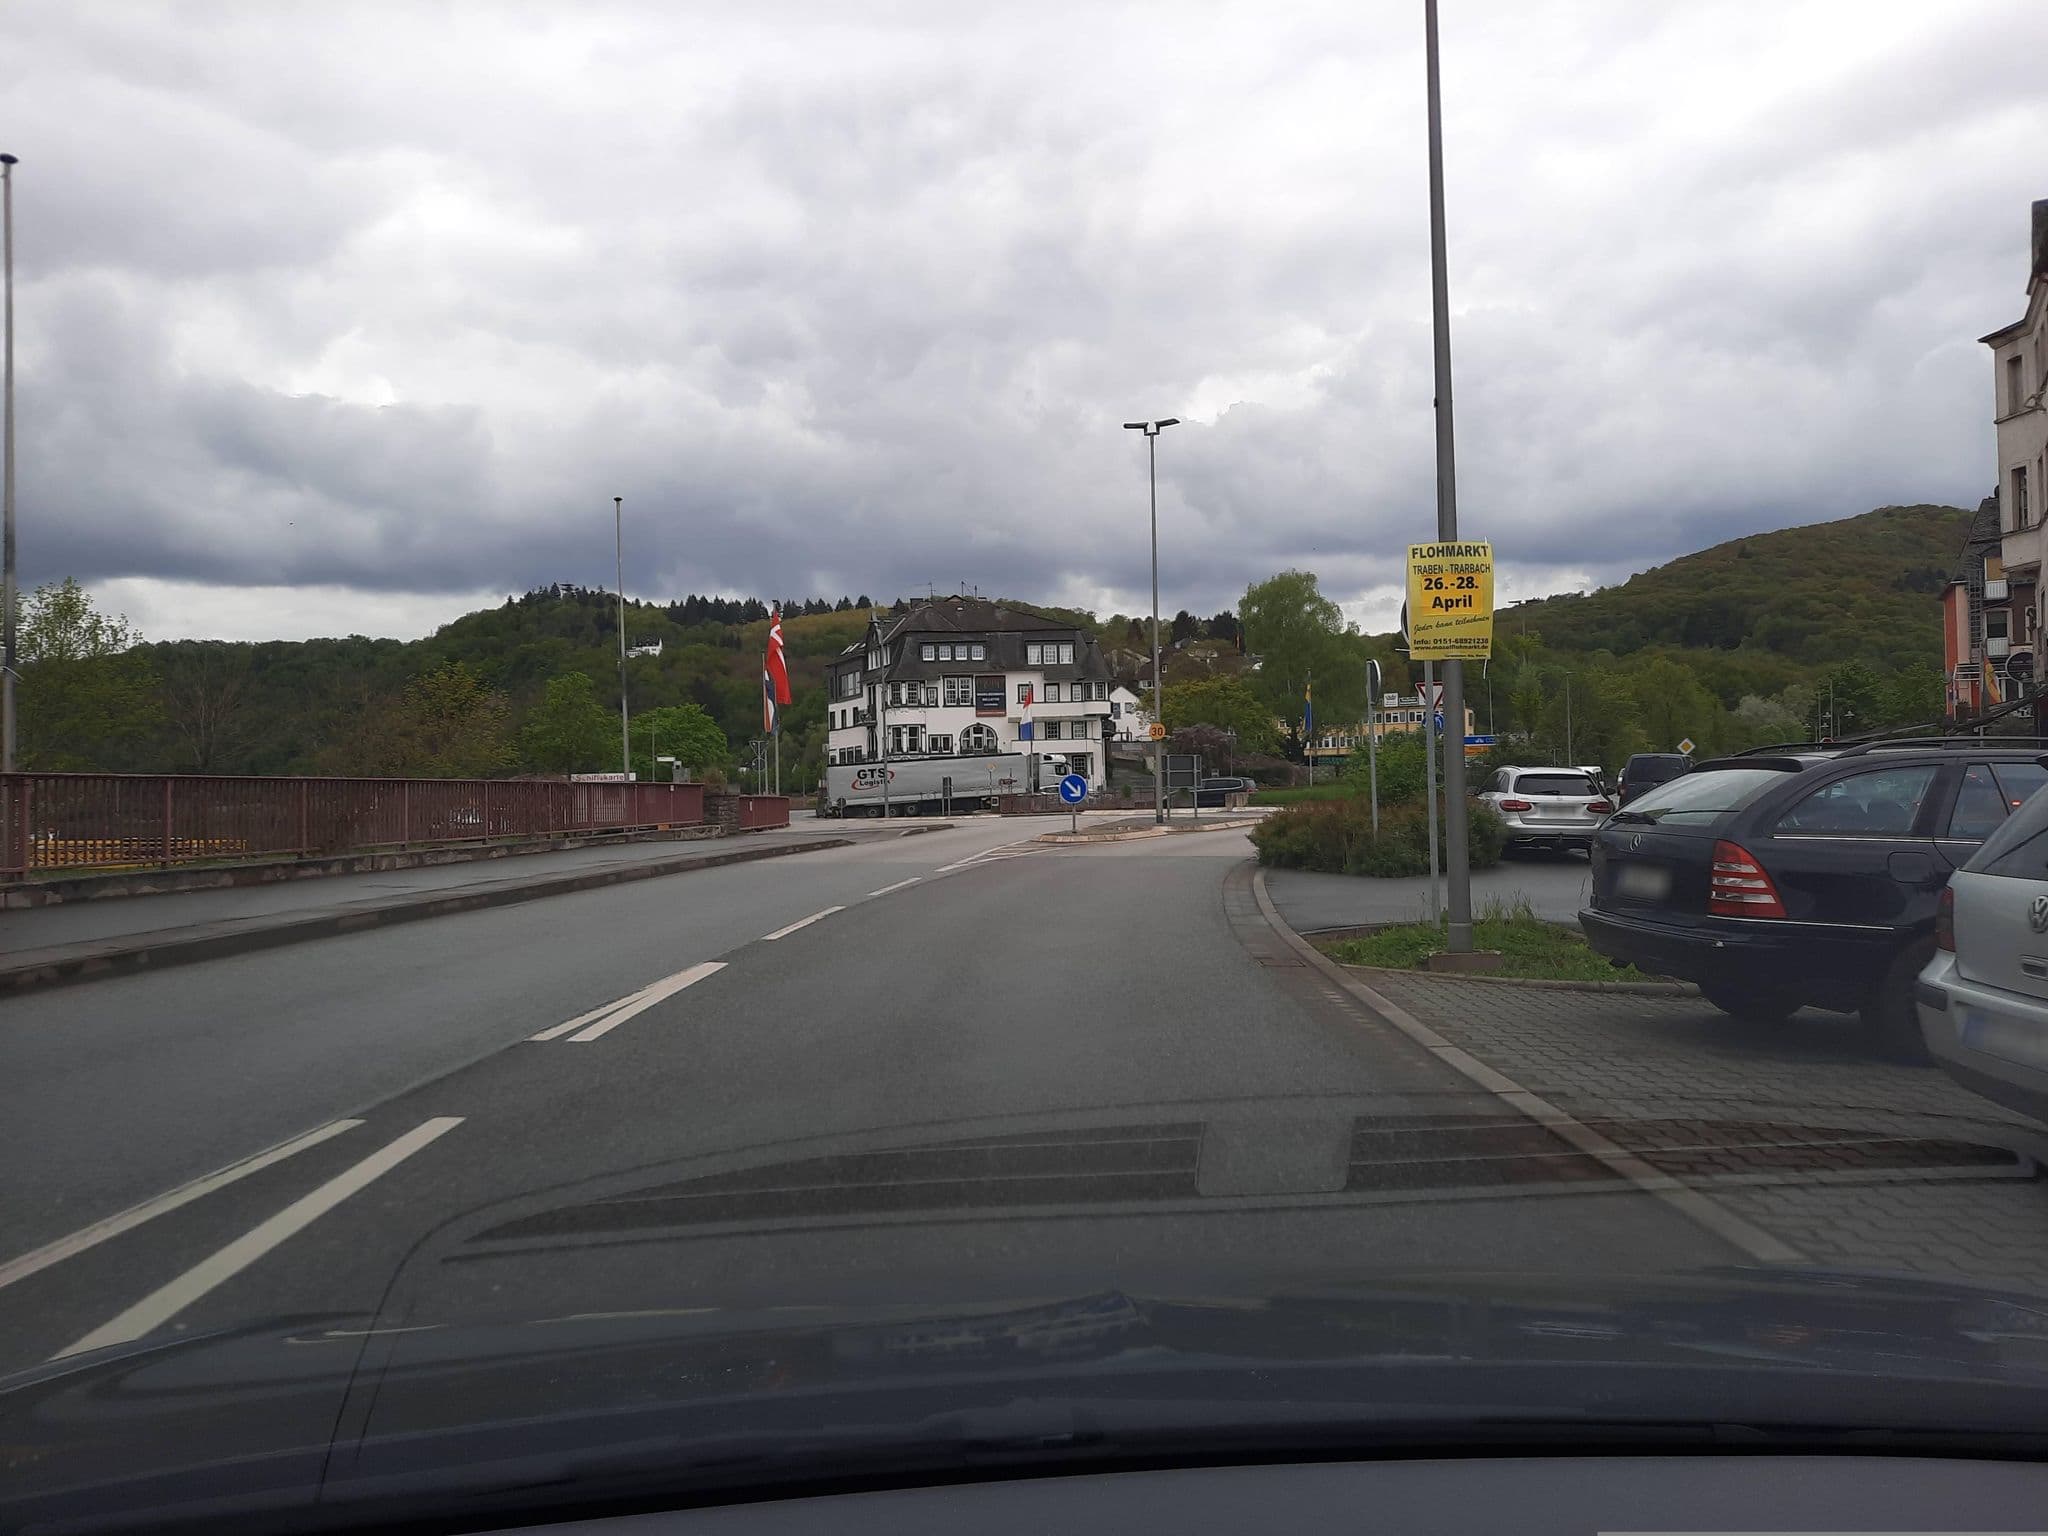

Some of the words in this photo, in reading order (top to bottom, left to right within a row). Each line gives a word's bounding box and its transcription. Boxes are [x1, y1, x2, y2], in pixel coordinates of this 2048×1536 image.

[1412, 545, 1488, 559] FLOHMARKT
[1413, 564, 1443, 575] TRABEN
[1449, 563, 1490, 574] TRARBACH
[1432, 594, 1472, 612] April
[1151, 727, 1164, 736] 30
[857, 768, 885, 779] GTS
